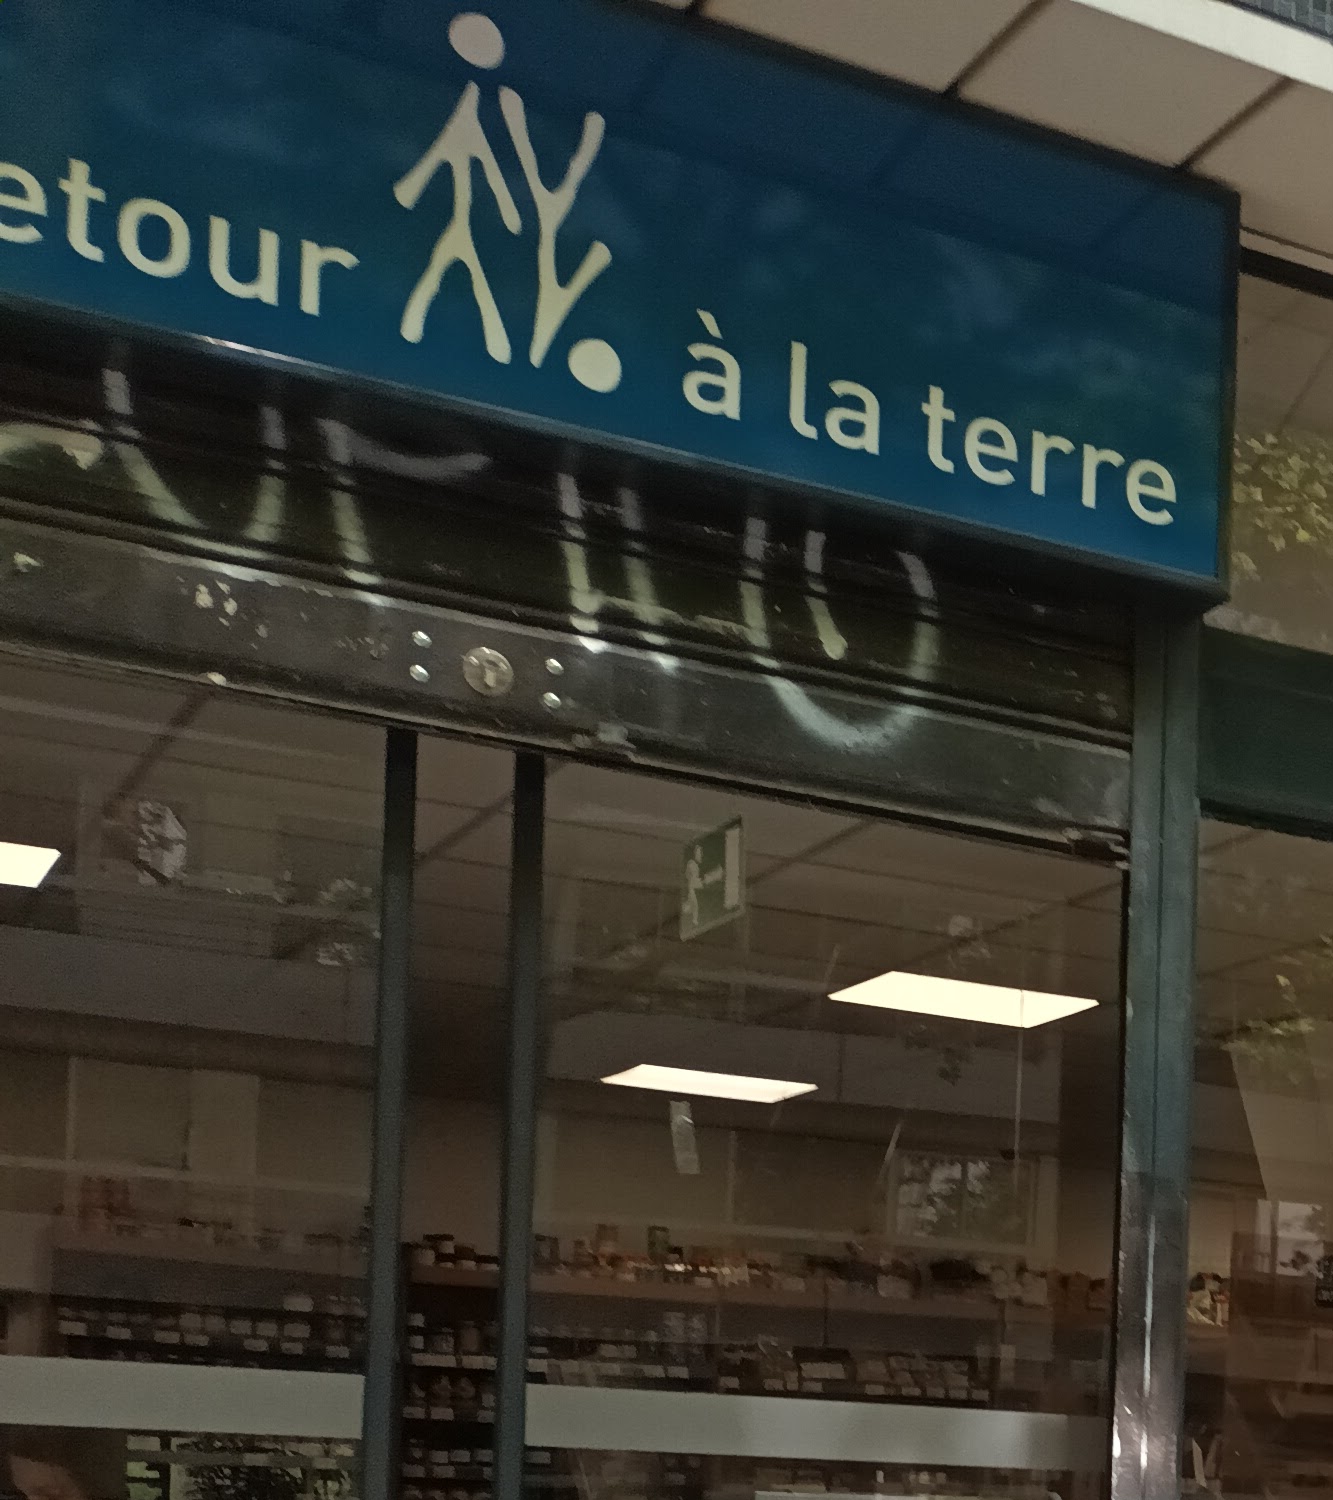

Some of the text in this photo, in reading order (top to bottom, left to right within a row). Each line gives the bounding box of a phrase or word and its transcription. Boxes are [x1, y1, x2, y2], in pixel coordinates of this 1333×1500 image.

[0, 157, 1178, 528] etour à la terre
